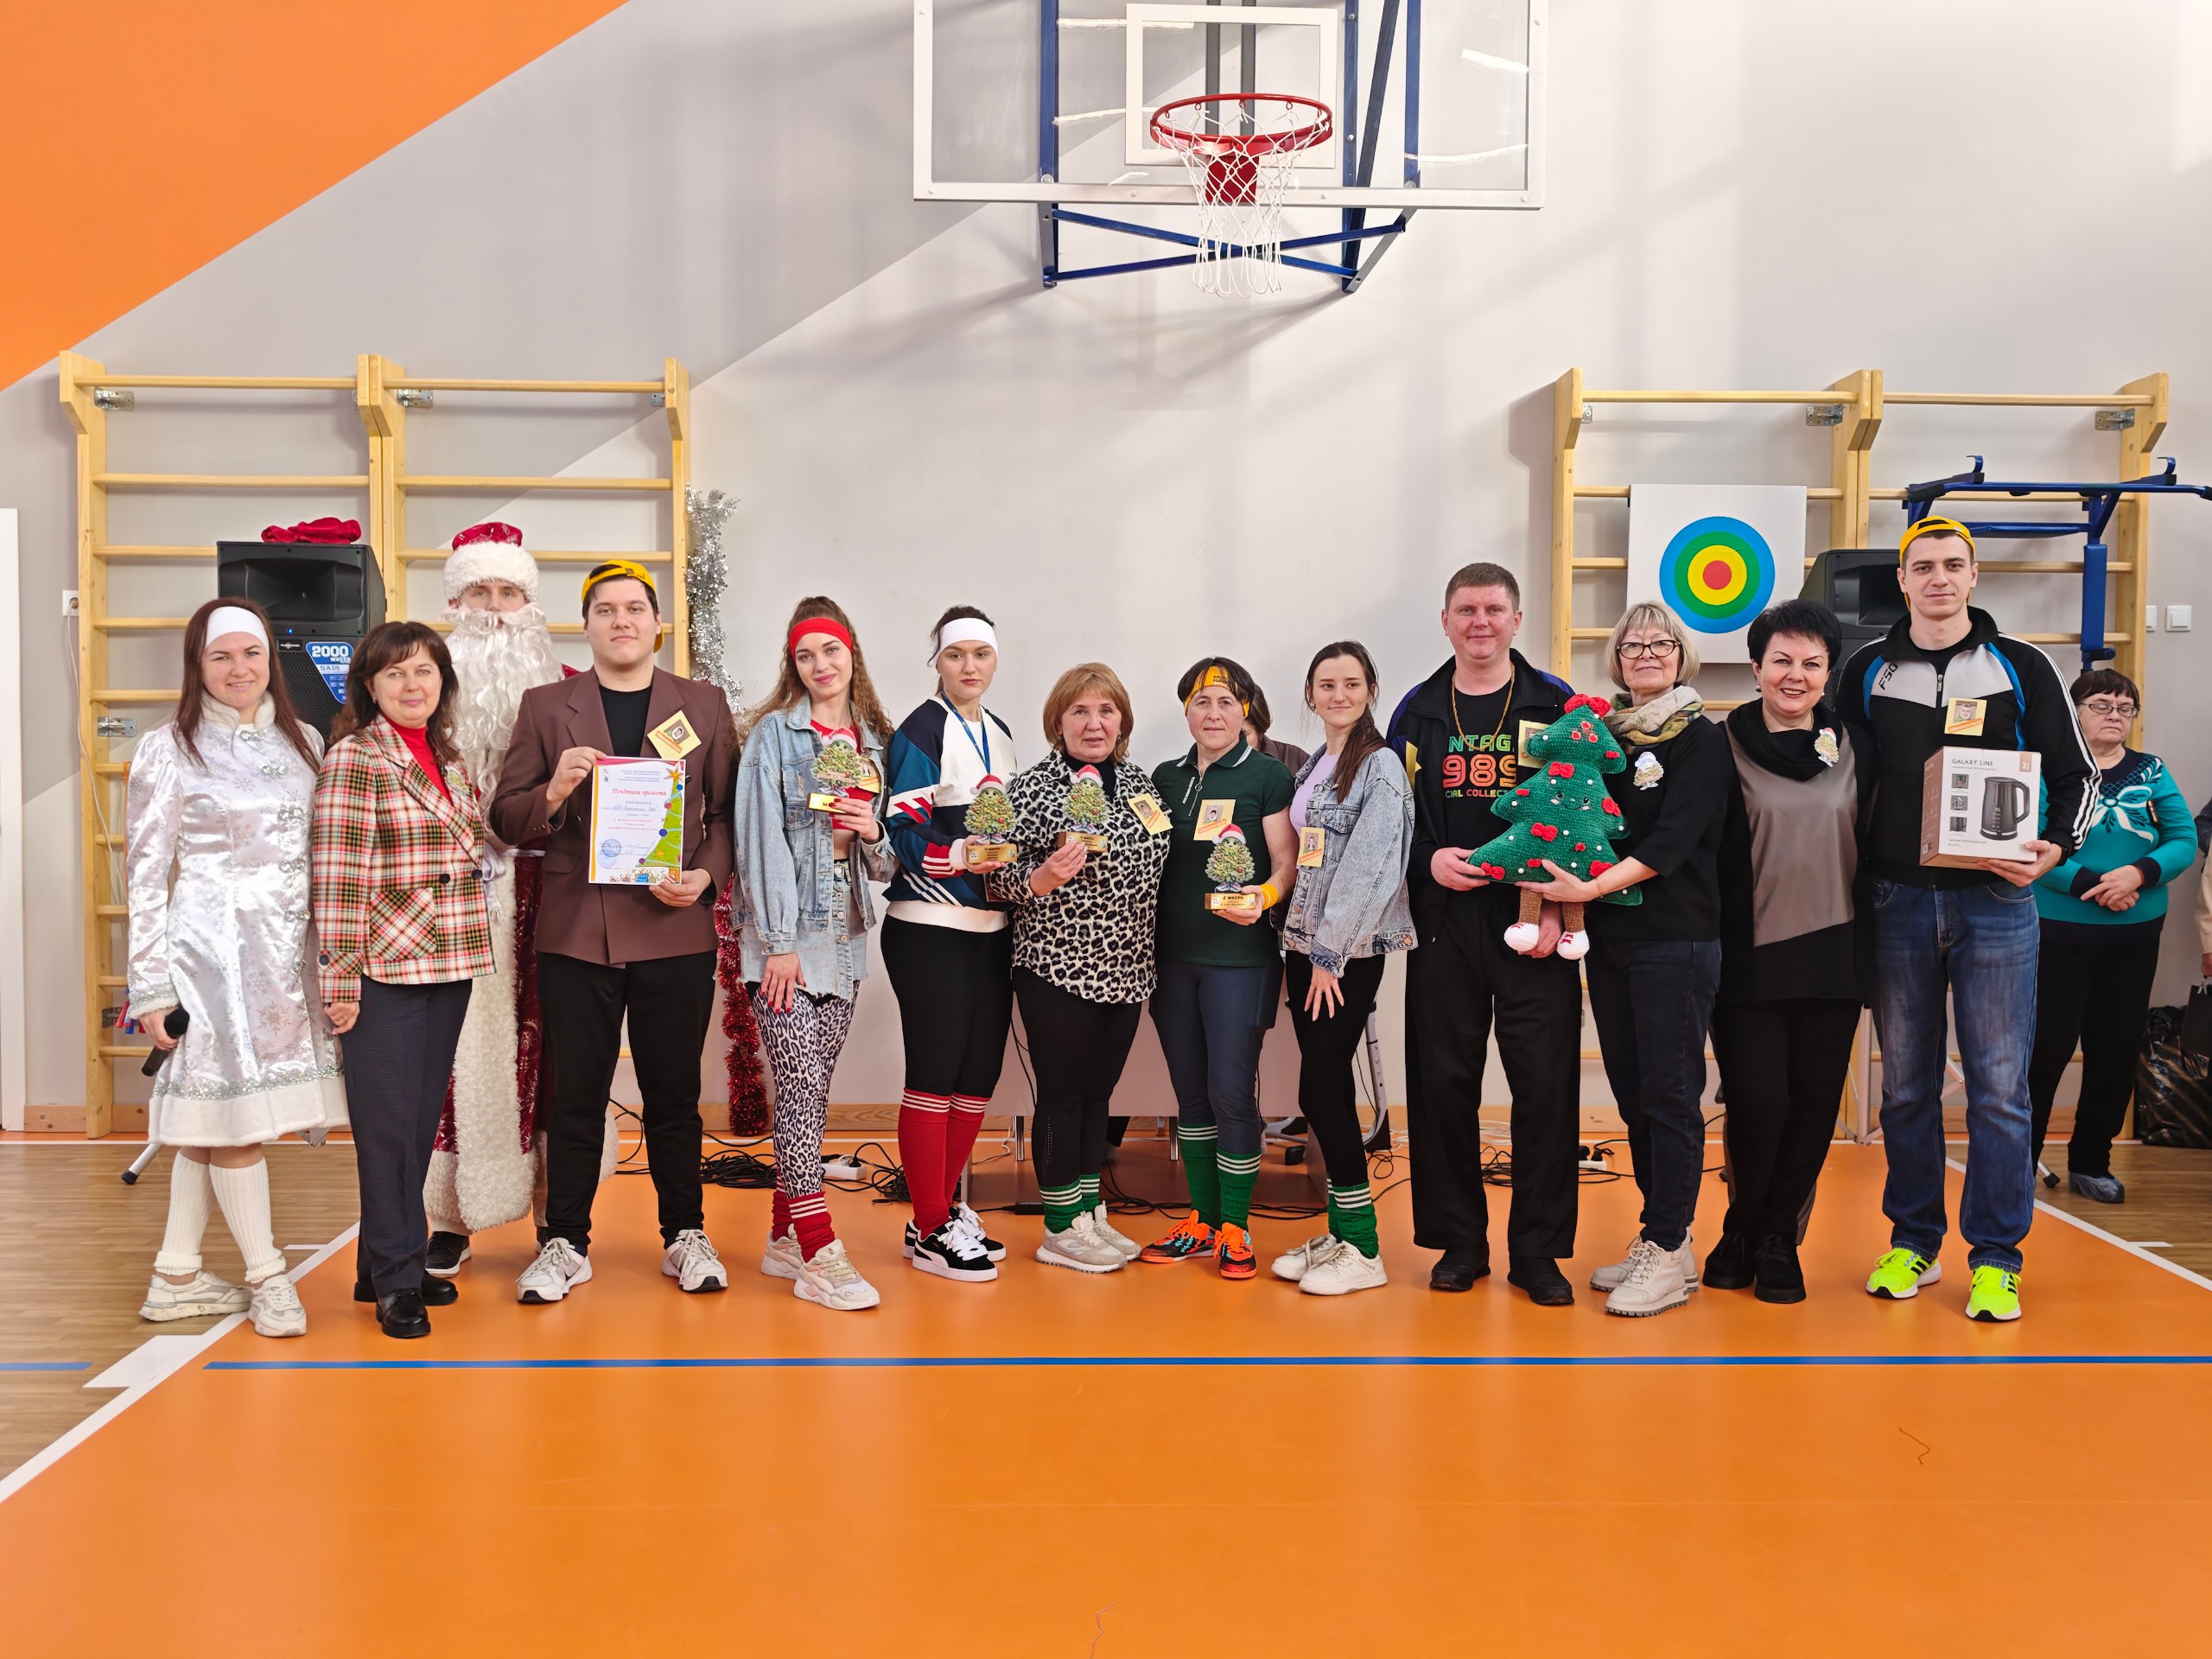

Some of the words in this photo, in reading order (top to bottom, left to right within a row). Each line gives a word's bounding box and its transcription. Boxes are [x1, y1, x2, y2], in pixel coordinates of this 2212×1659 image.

[312, 645, 349, 658] 2000
[1448, 734, 1515, 753] NTAG
[1442, 754, 1516, 788] 989
[1445, 790, 1464, 798] CIAL
